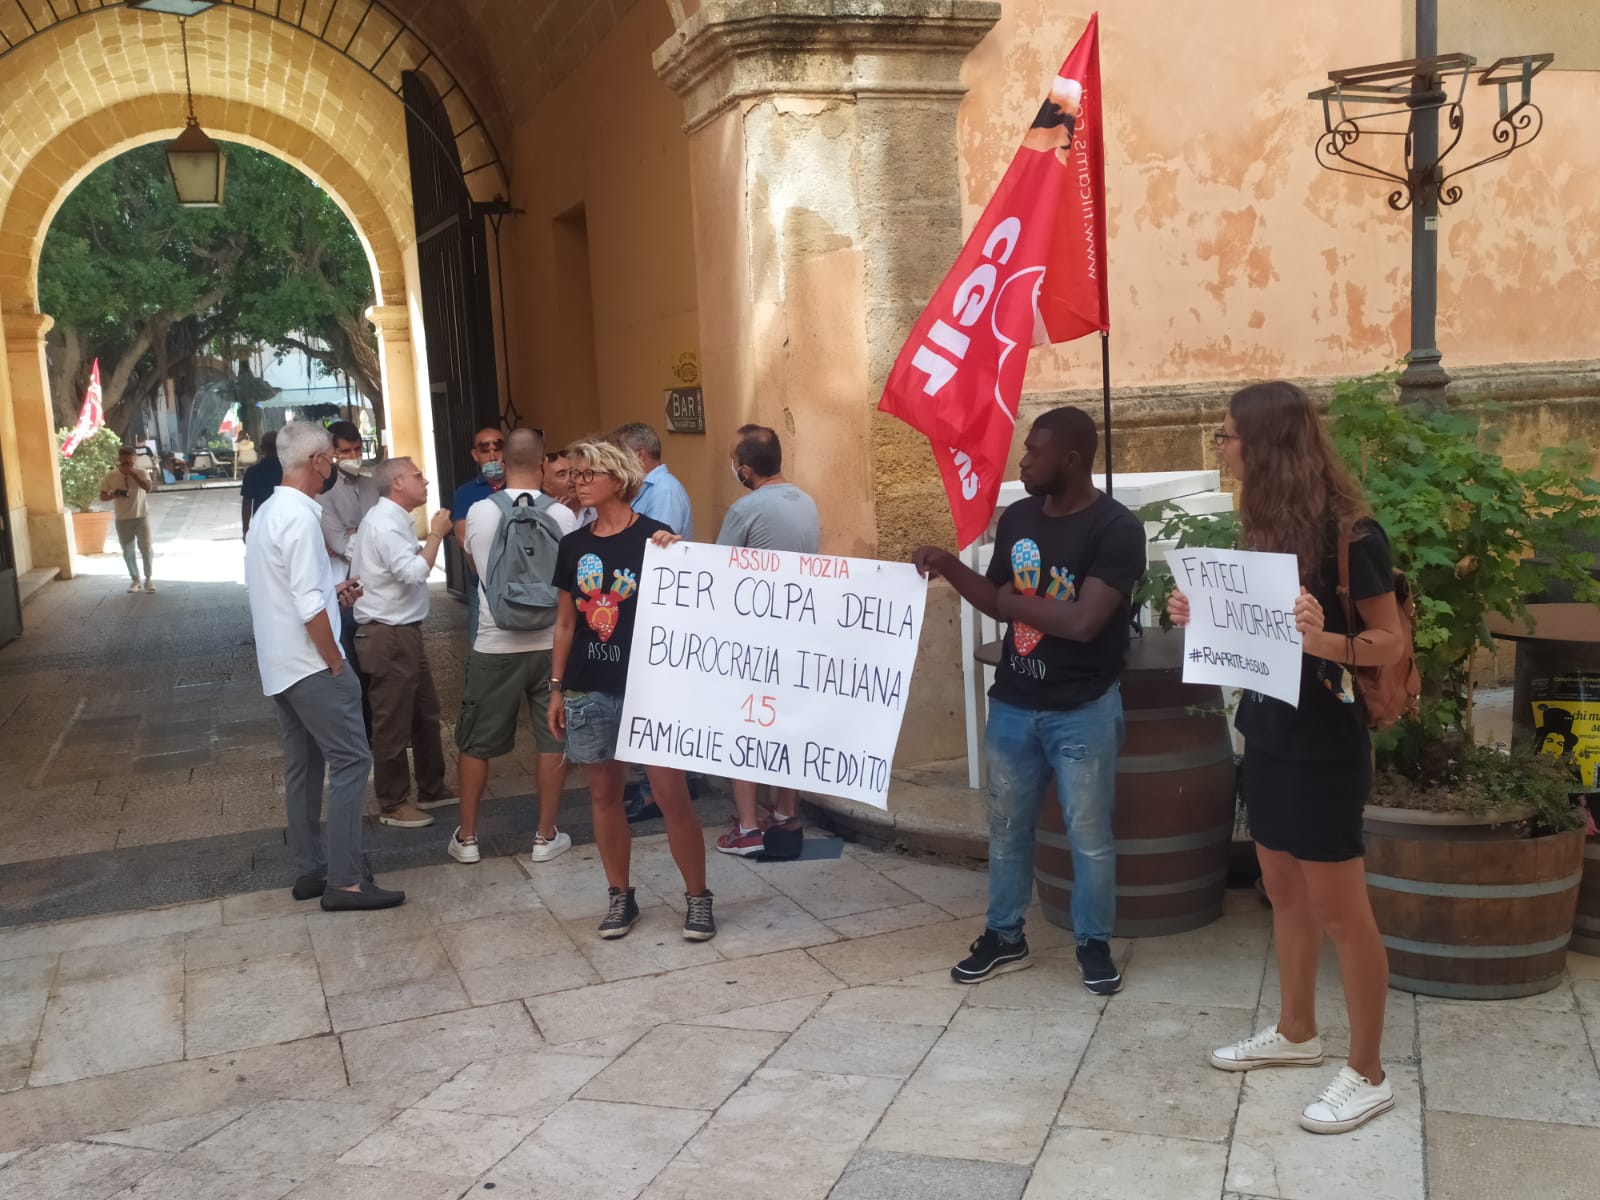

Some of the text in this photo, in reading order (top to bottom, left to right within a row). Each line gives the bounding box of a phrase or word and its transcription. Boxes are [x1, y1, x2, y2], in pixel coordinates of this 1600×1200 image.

[672, 392, 696, 417] BAR
[728, 546, 850, 579] ASSUD MOZIA
[1181, 556, 1249, 595] FATECI
[651, 567, 914, 640] PER COLPA DELLA
[1209, 595, 1299, 645] LAVORARE
[587, 641, 621, 663] ASSUD
[648, 625, 902, 711] BUROCRAZIA ITALIANA
[740, 693, 777, 727] 15
[629, 717, 724, 762] FAMIGLIE
[730, 735, 790, 775] SENZA
